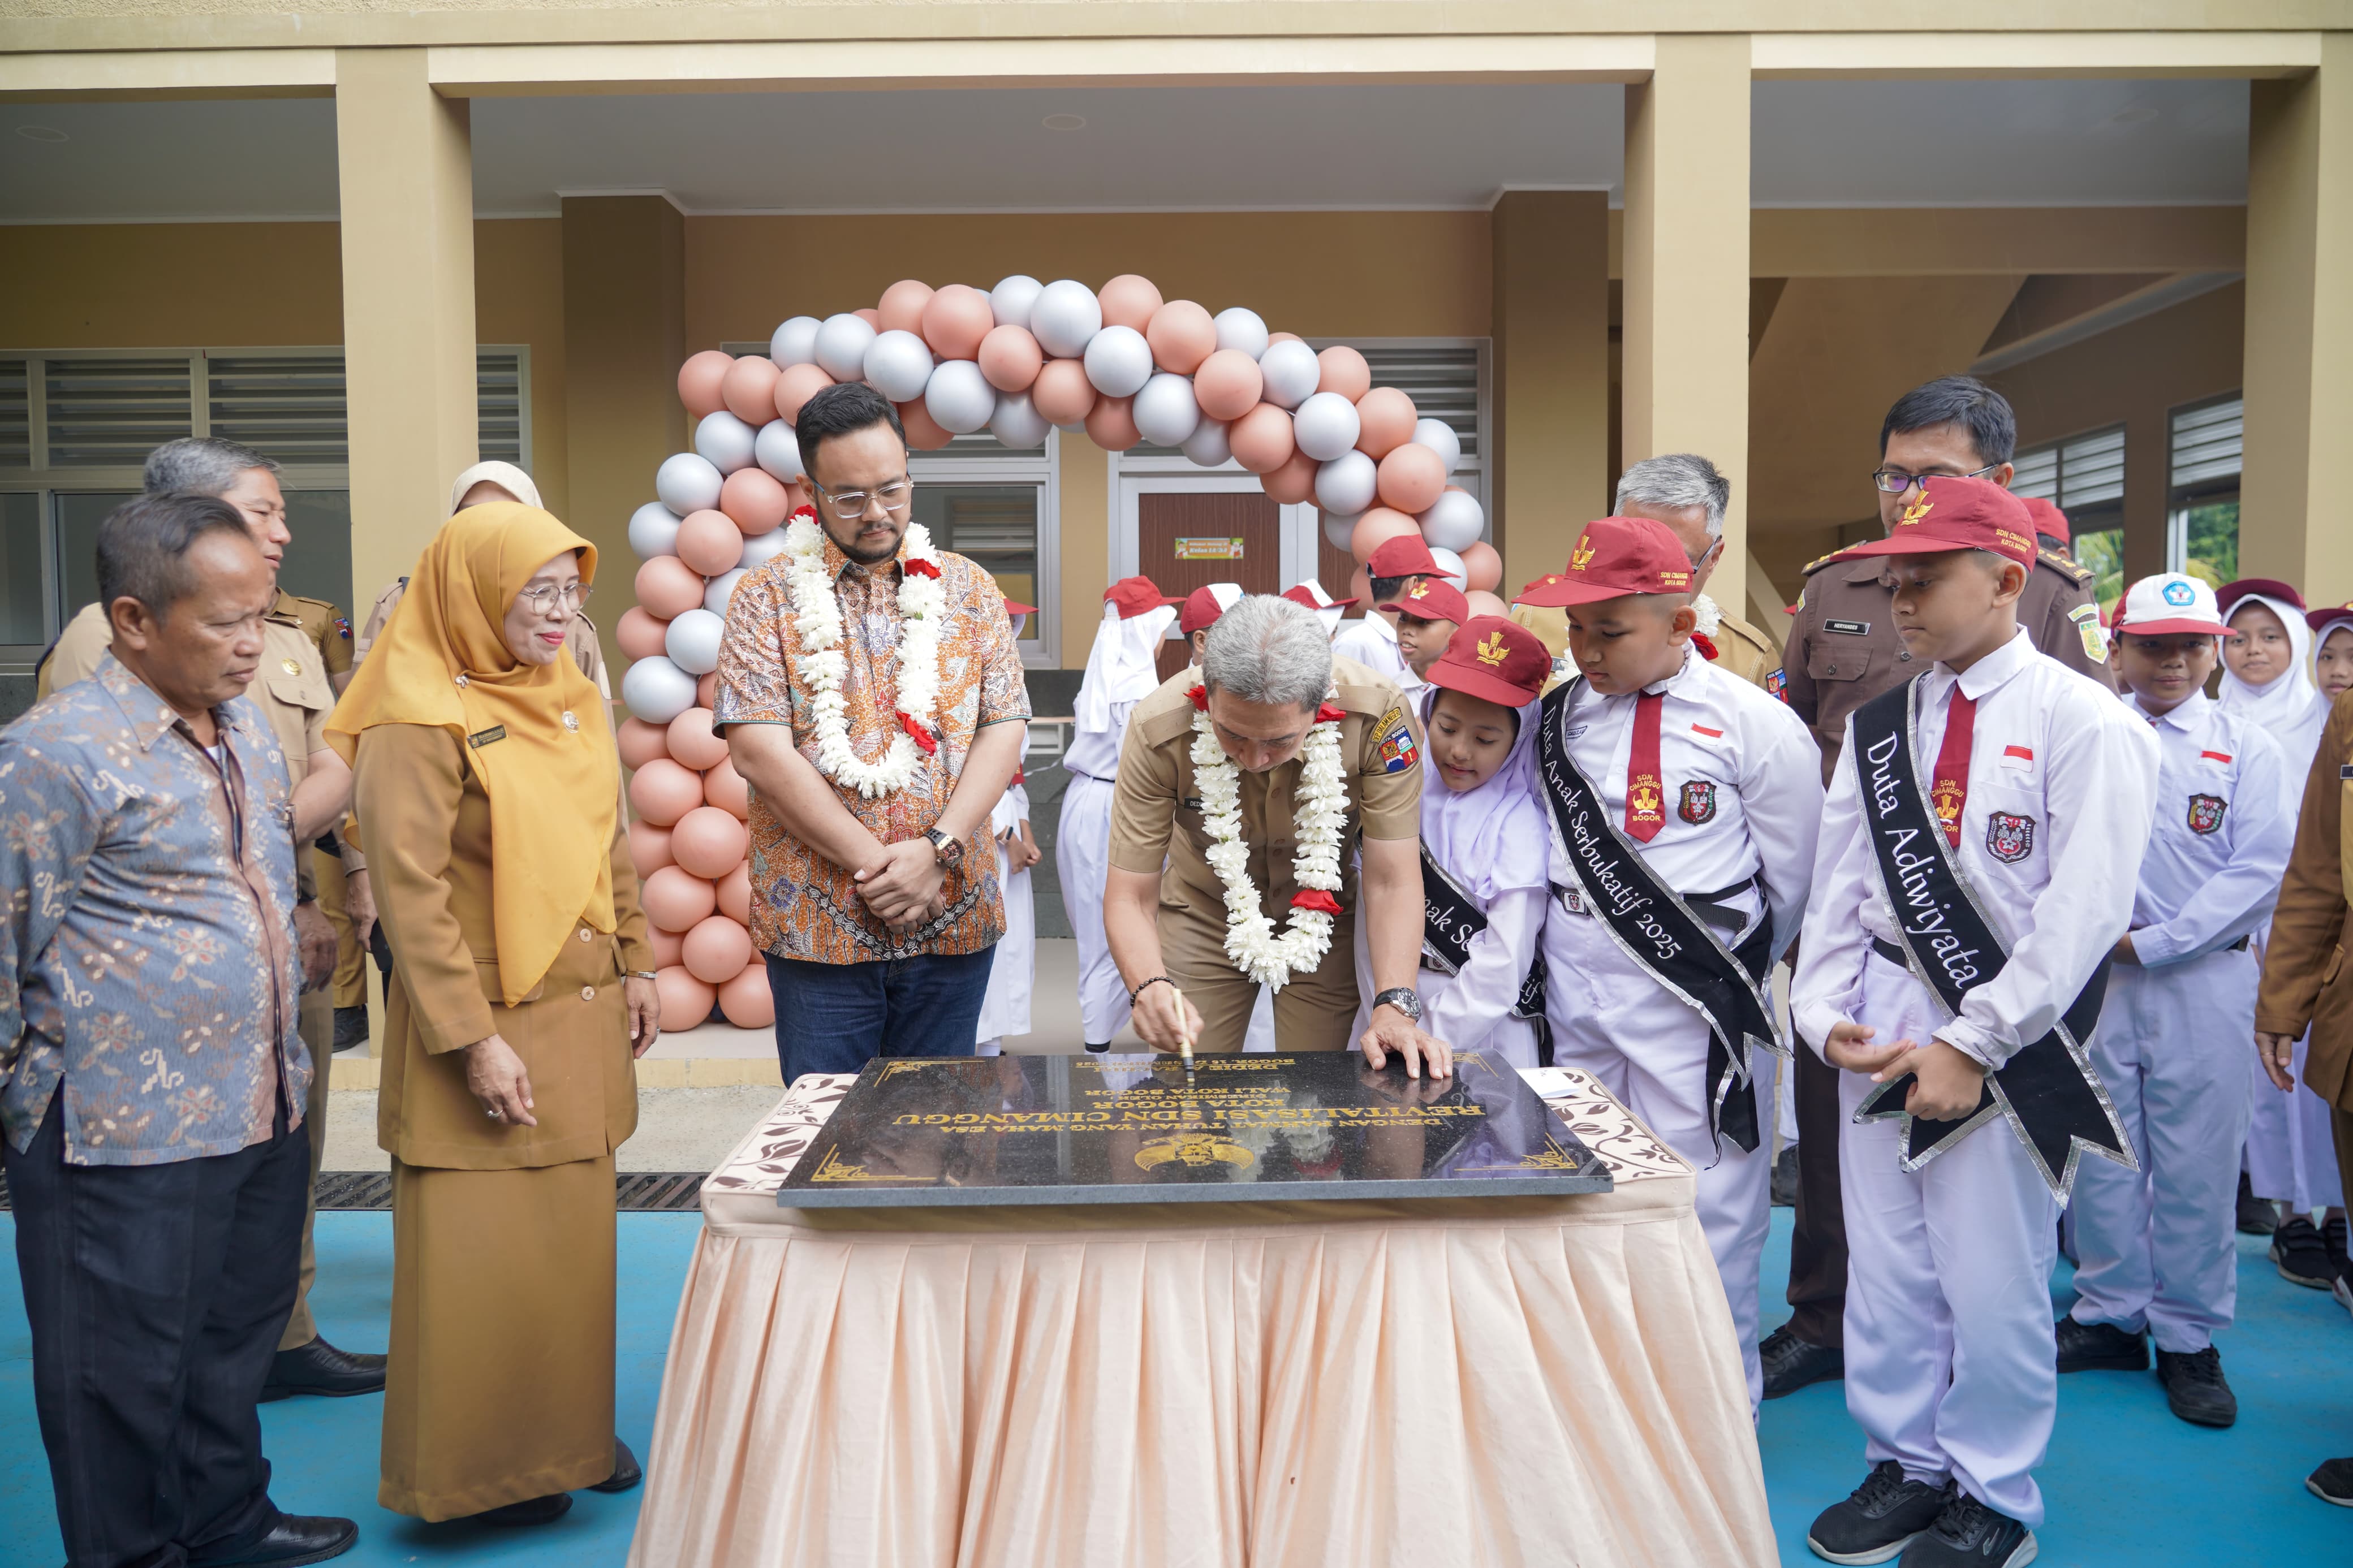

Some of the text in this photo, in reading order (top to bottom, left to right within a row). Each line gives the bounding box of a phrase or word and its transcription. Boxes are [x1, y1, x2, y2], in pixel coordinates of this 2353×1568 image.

[1996, 529, 2009, 538] SDN
[2001, 538, 2014, 547] KOTA
[1391, 726, 1407, 738] BOGOR
[1629, 780, 1661, 791] CIMANGGU
[1940, 779, 1956, 788] SDN
[1932, 787, 1964, 797] CIMANGGU
[2005, 816, 2021, 828] SD
[1543, 703, 1682, 960] Duta Anak Serbukatif 2025
[1867, 731, 1979, 990] Duta Adiwiyata
[892, 1105, 1485, 1125] REVITALISASI SDN CIMANGGU
